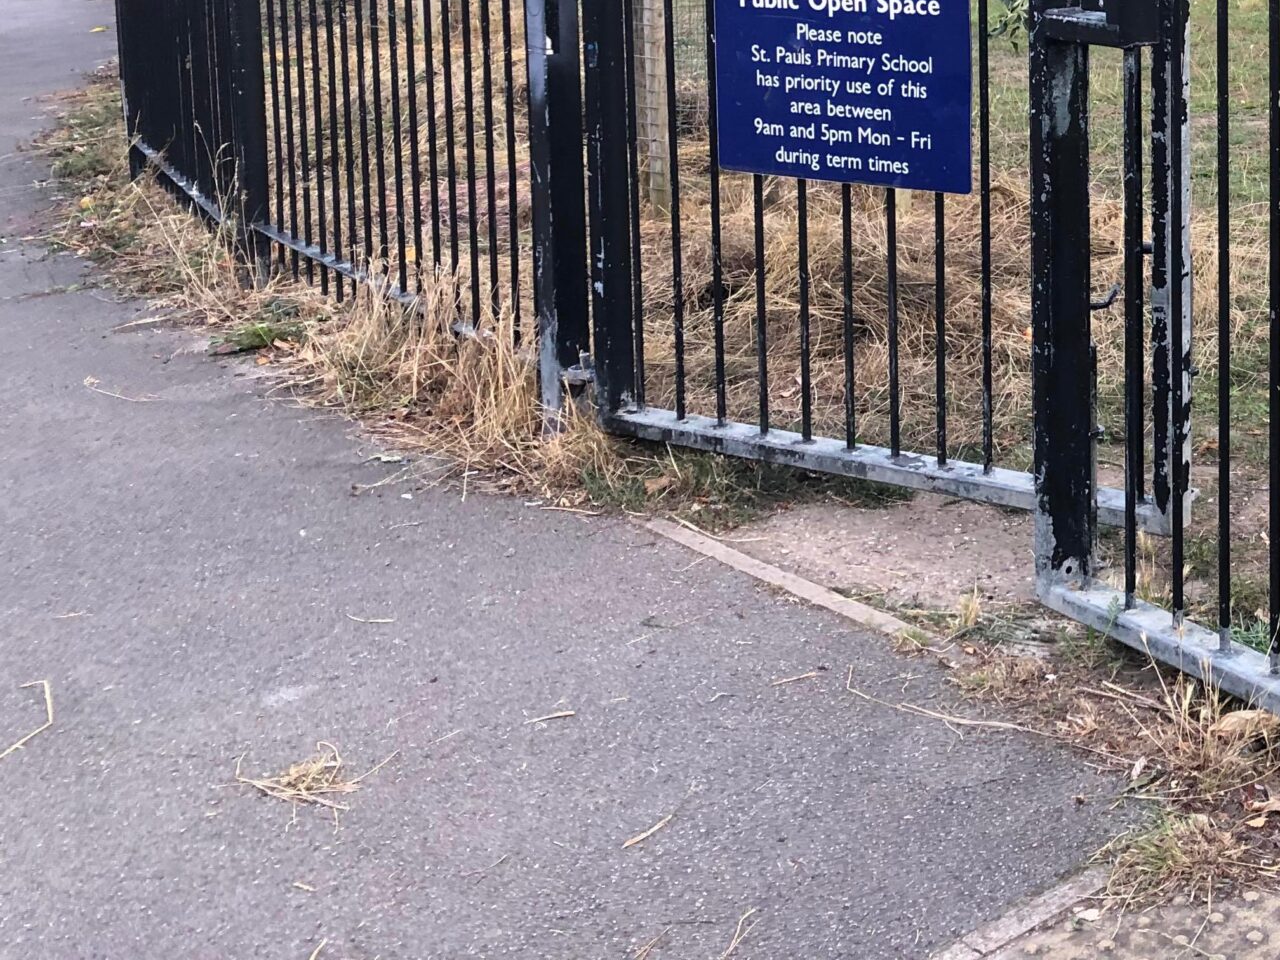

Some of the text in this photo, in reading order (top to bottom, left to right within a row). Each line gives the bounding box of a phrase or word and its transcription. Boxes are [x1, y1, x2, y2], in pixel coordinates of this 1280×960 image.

[796, 22, 883, 46] Please note
[751, 44, 933, 75] St. Pauls Primary School
[756, 69, 927, 99] has priority use of this
[790, 99, 892, 122] area between
[753, 117, 784, 137] 9am
[789, 122, 815, 140] and
[820, 123, 853, 146] 5pm
[857, 126, 891, 146] Mon
[911, 131, 931, 150] Fri
[775, 145, 909, 175] during term times
